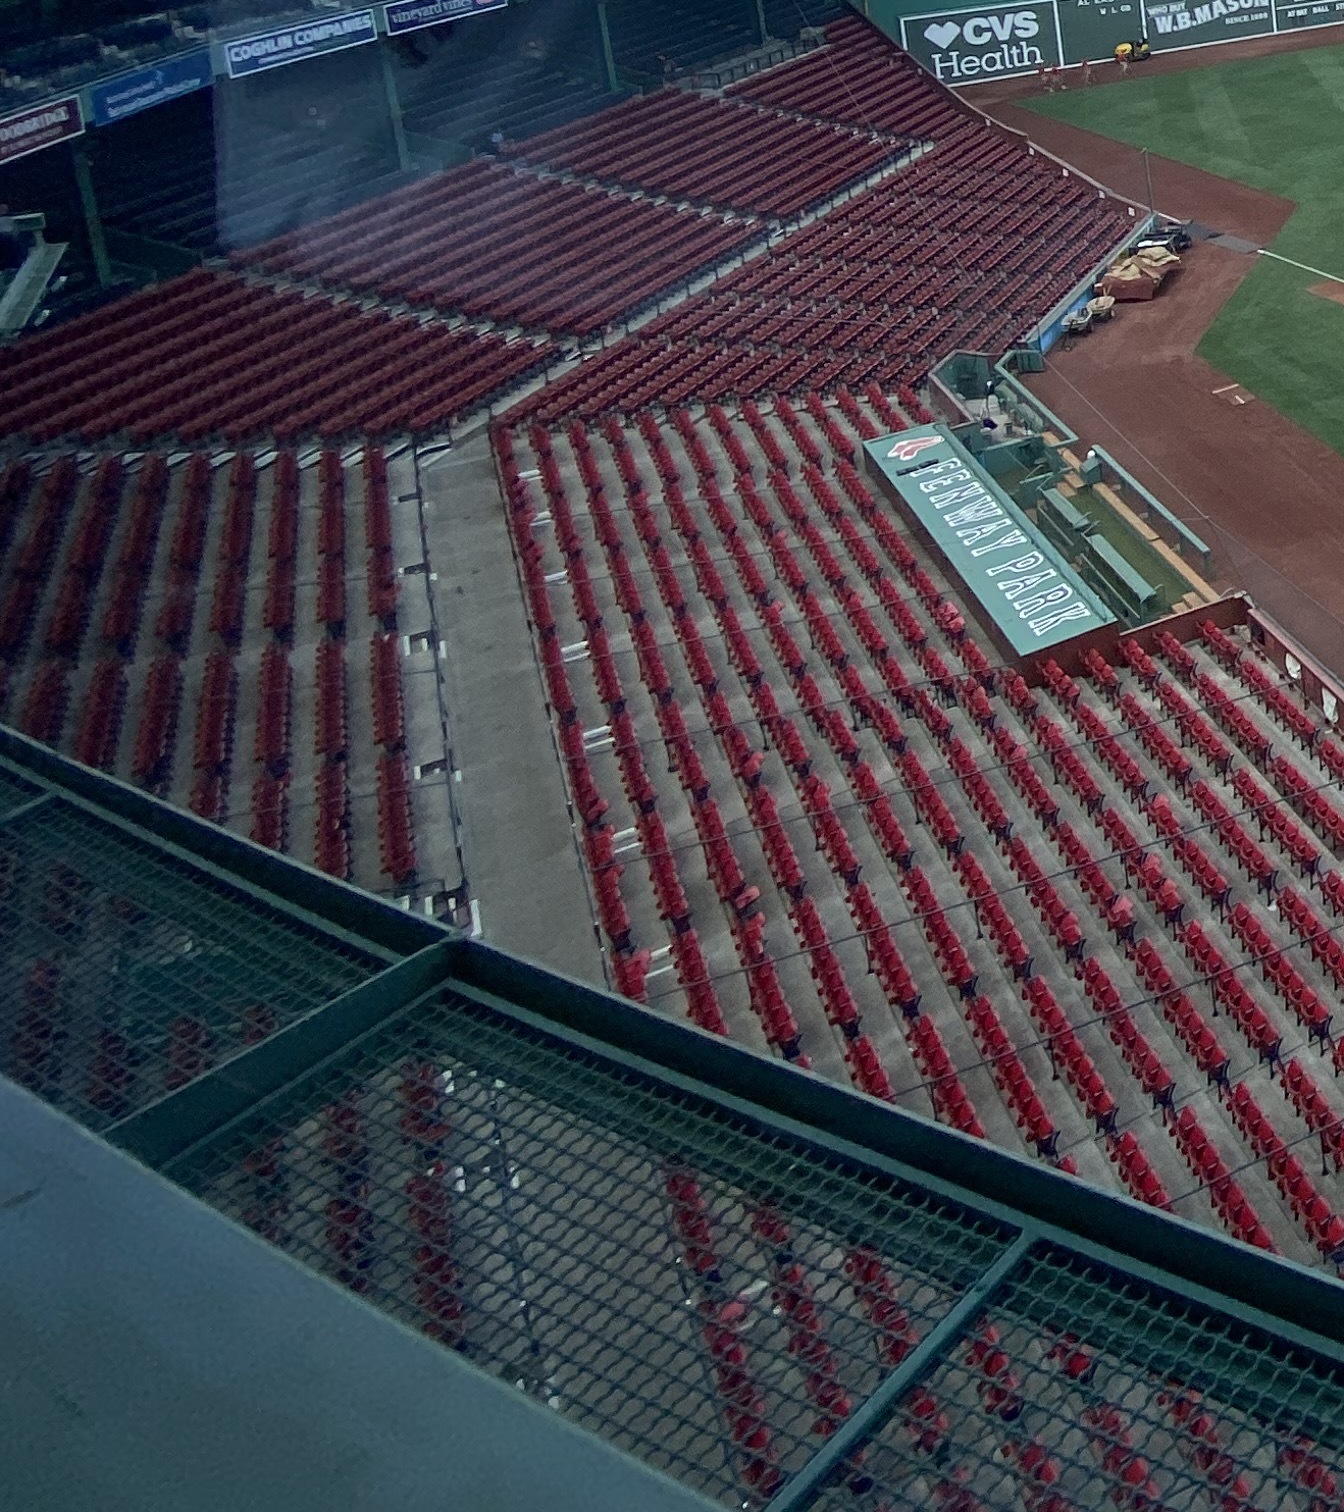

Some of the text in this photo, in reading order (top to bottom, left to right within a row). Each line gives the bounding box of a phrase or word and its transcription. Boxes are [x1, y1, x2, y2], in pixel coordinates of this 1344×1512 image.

[1169, 0, 1187, 12] BUY
[1225, 15, 1249, 25] SINCE
[231, 32, 294, 62] COGHLIN
[296, 14, 372, 46] COMPANIES
[962, 10, 1039, 46] CVS
[931, 41, 1045, 80] Health
[909, 456, 1093, 637] FENWAY PARK
